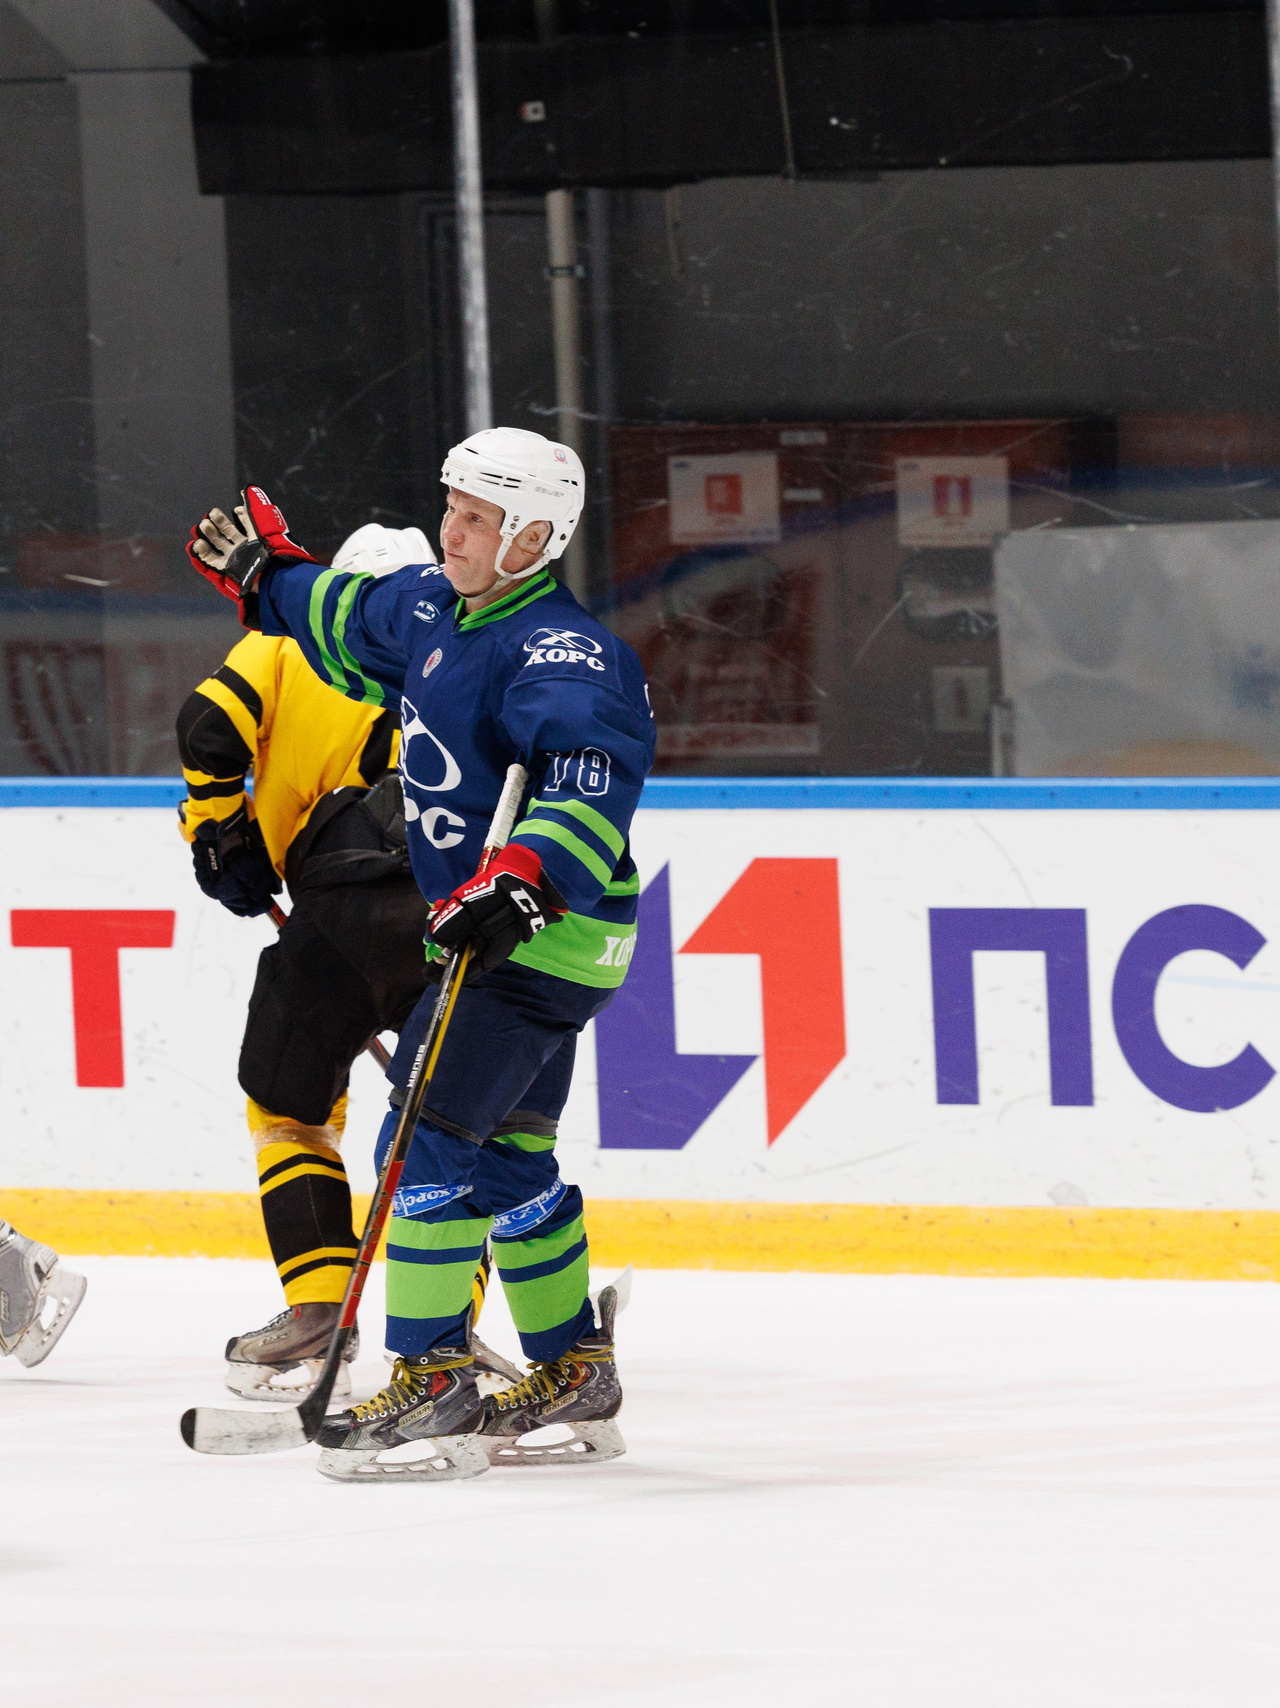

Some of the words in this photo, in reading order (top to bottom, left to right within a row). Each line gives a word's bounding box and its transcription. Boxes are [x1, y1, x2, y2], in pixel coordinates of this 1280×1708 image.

[251, 487, 268, 506] CCM
[524, 648, 606, 672] ХОРС
[433, 902, 457, 927] CCM
